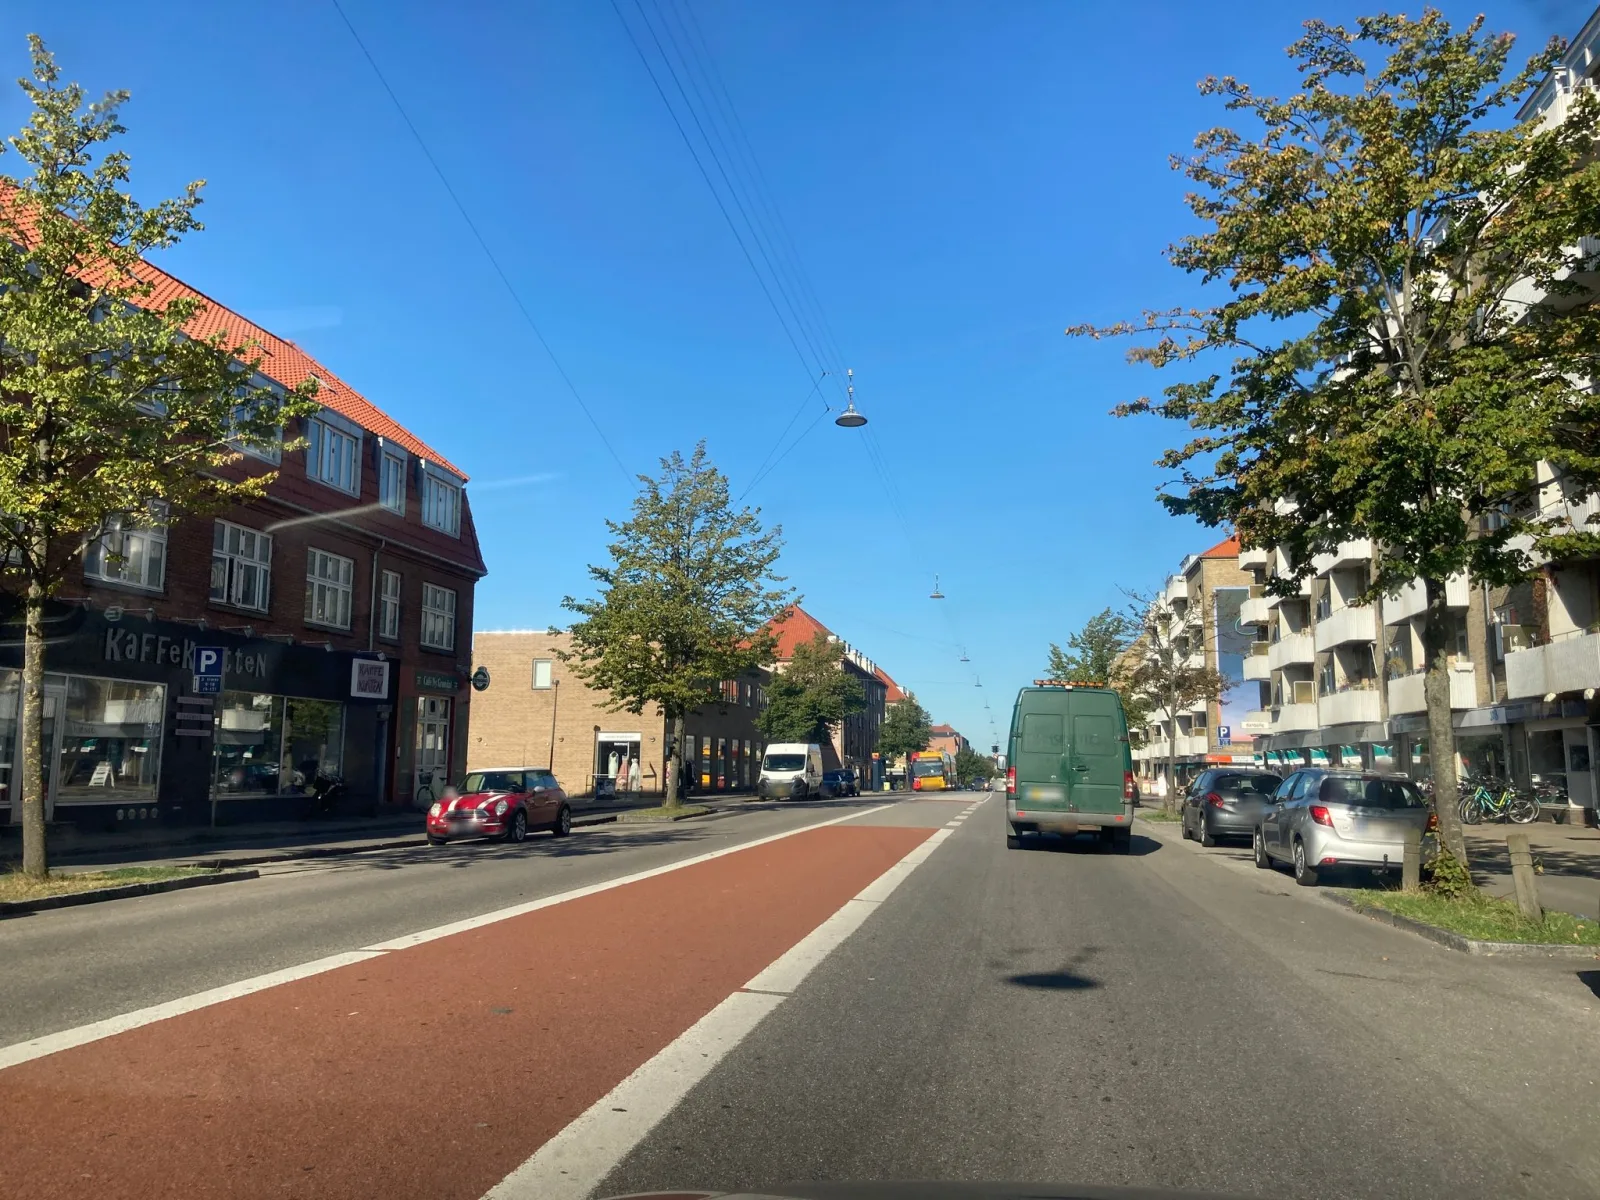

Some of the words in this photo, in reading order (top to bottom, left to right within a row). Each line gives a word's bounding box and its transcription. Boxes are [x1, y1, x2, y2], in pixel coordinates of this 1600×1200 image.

[105, 627, 267, 678] KaFFeKtteN
[200, 650, 217, 673] P
[1220, 727, 1228, 737] P
